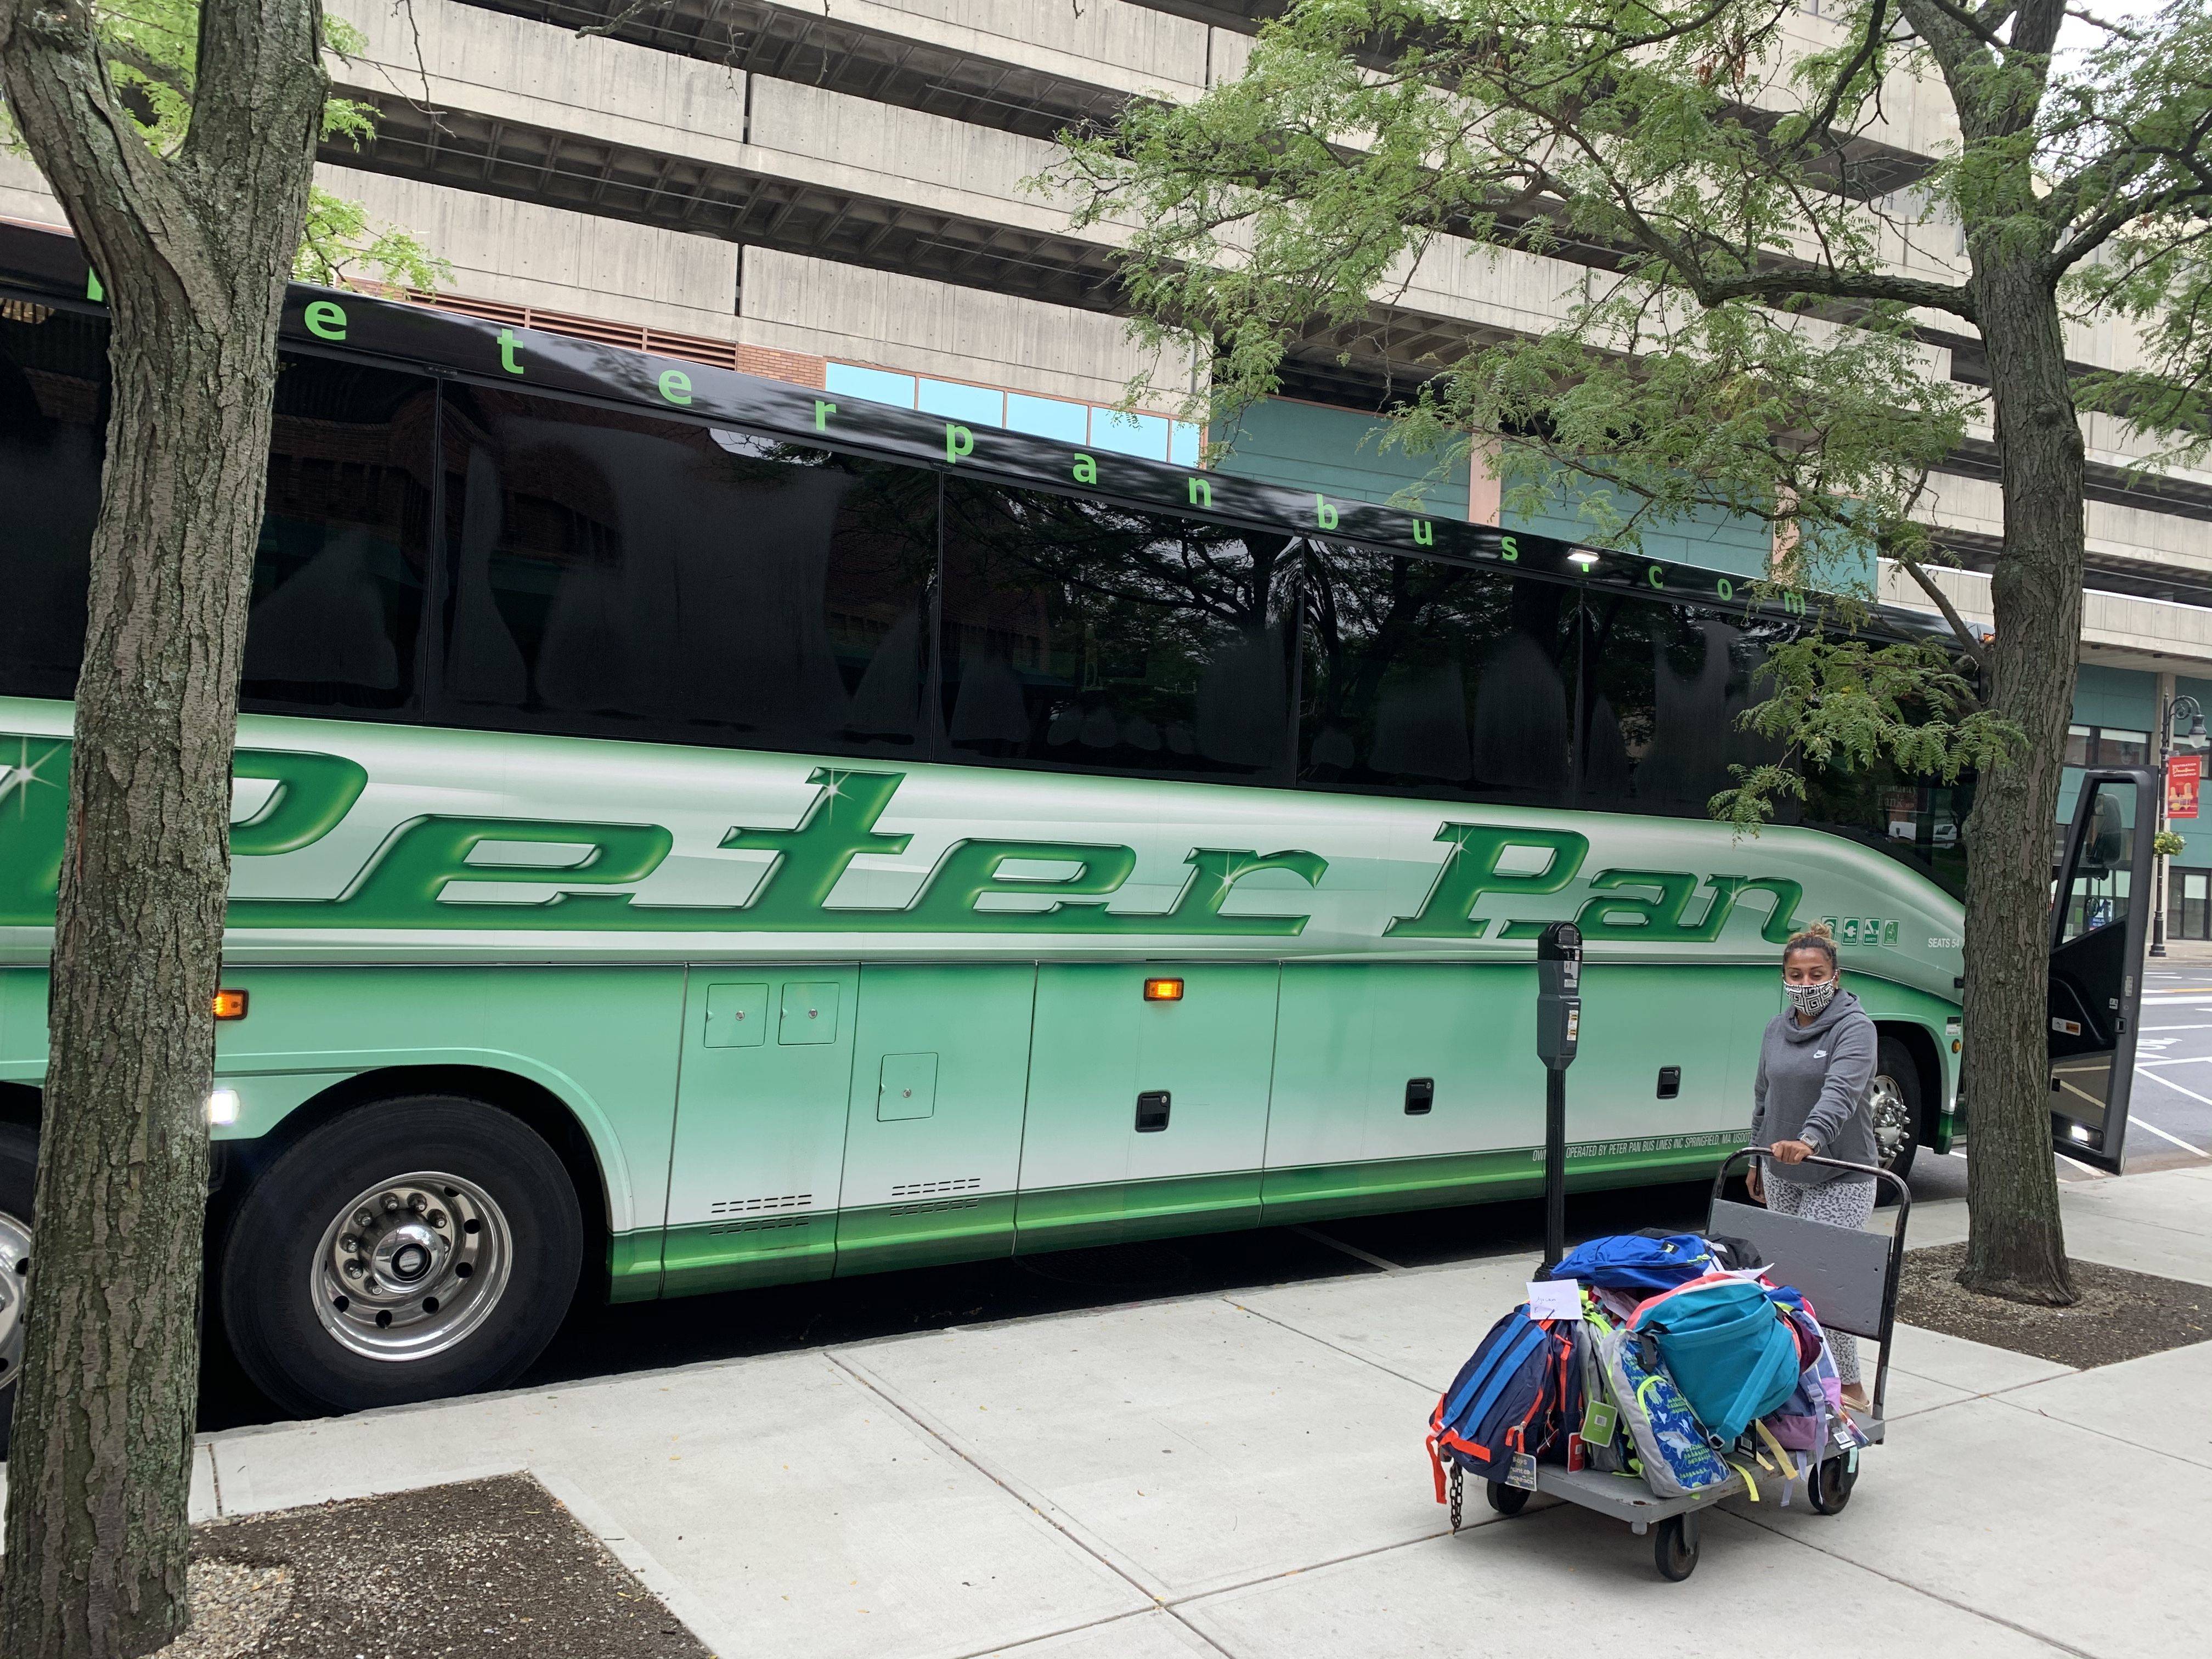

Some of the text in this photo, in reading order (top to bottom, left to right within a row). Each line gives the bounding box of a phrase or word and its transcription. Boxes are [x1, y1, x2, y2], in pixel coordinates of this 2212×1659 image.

[1381, 821, 1802, 944] Pan
[1928, 938, 1960, 948] SEATS 54
[1566, 1146, 1597, 1158] OPERATED
[1598, 1144, 1607, 1155] BY
[1609, 1143, 1628, 1155] PETER
[1628, 1142, 1641, 1153] PAN
[1642, 1141, 1655, 1152] BUS
[1656, 1139, 1672, 1150] LINES
[1673, 1138, 1684, 1149] INC
[1685, 1135, 1720, 1148] SPRINGFIELD,
[1722, 1134, 1731, 1144] MA
